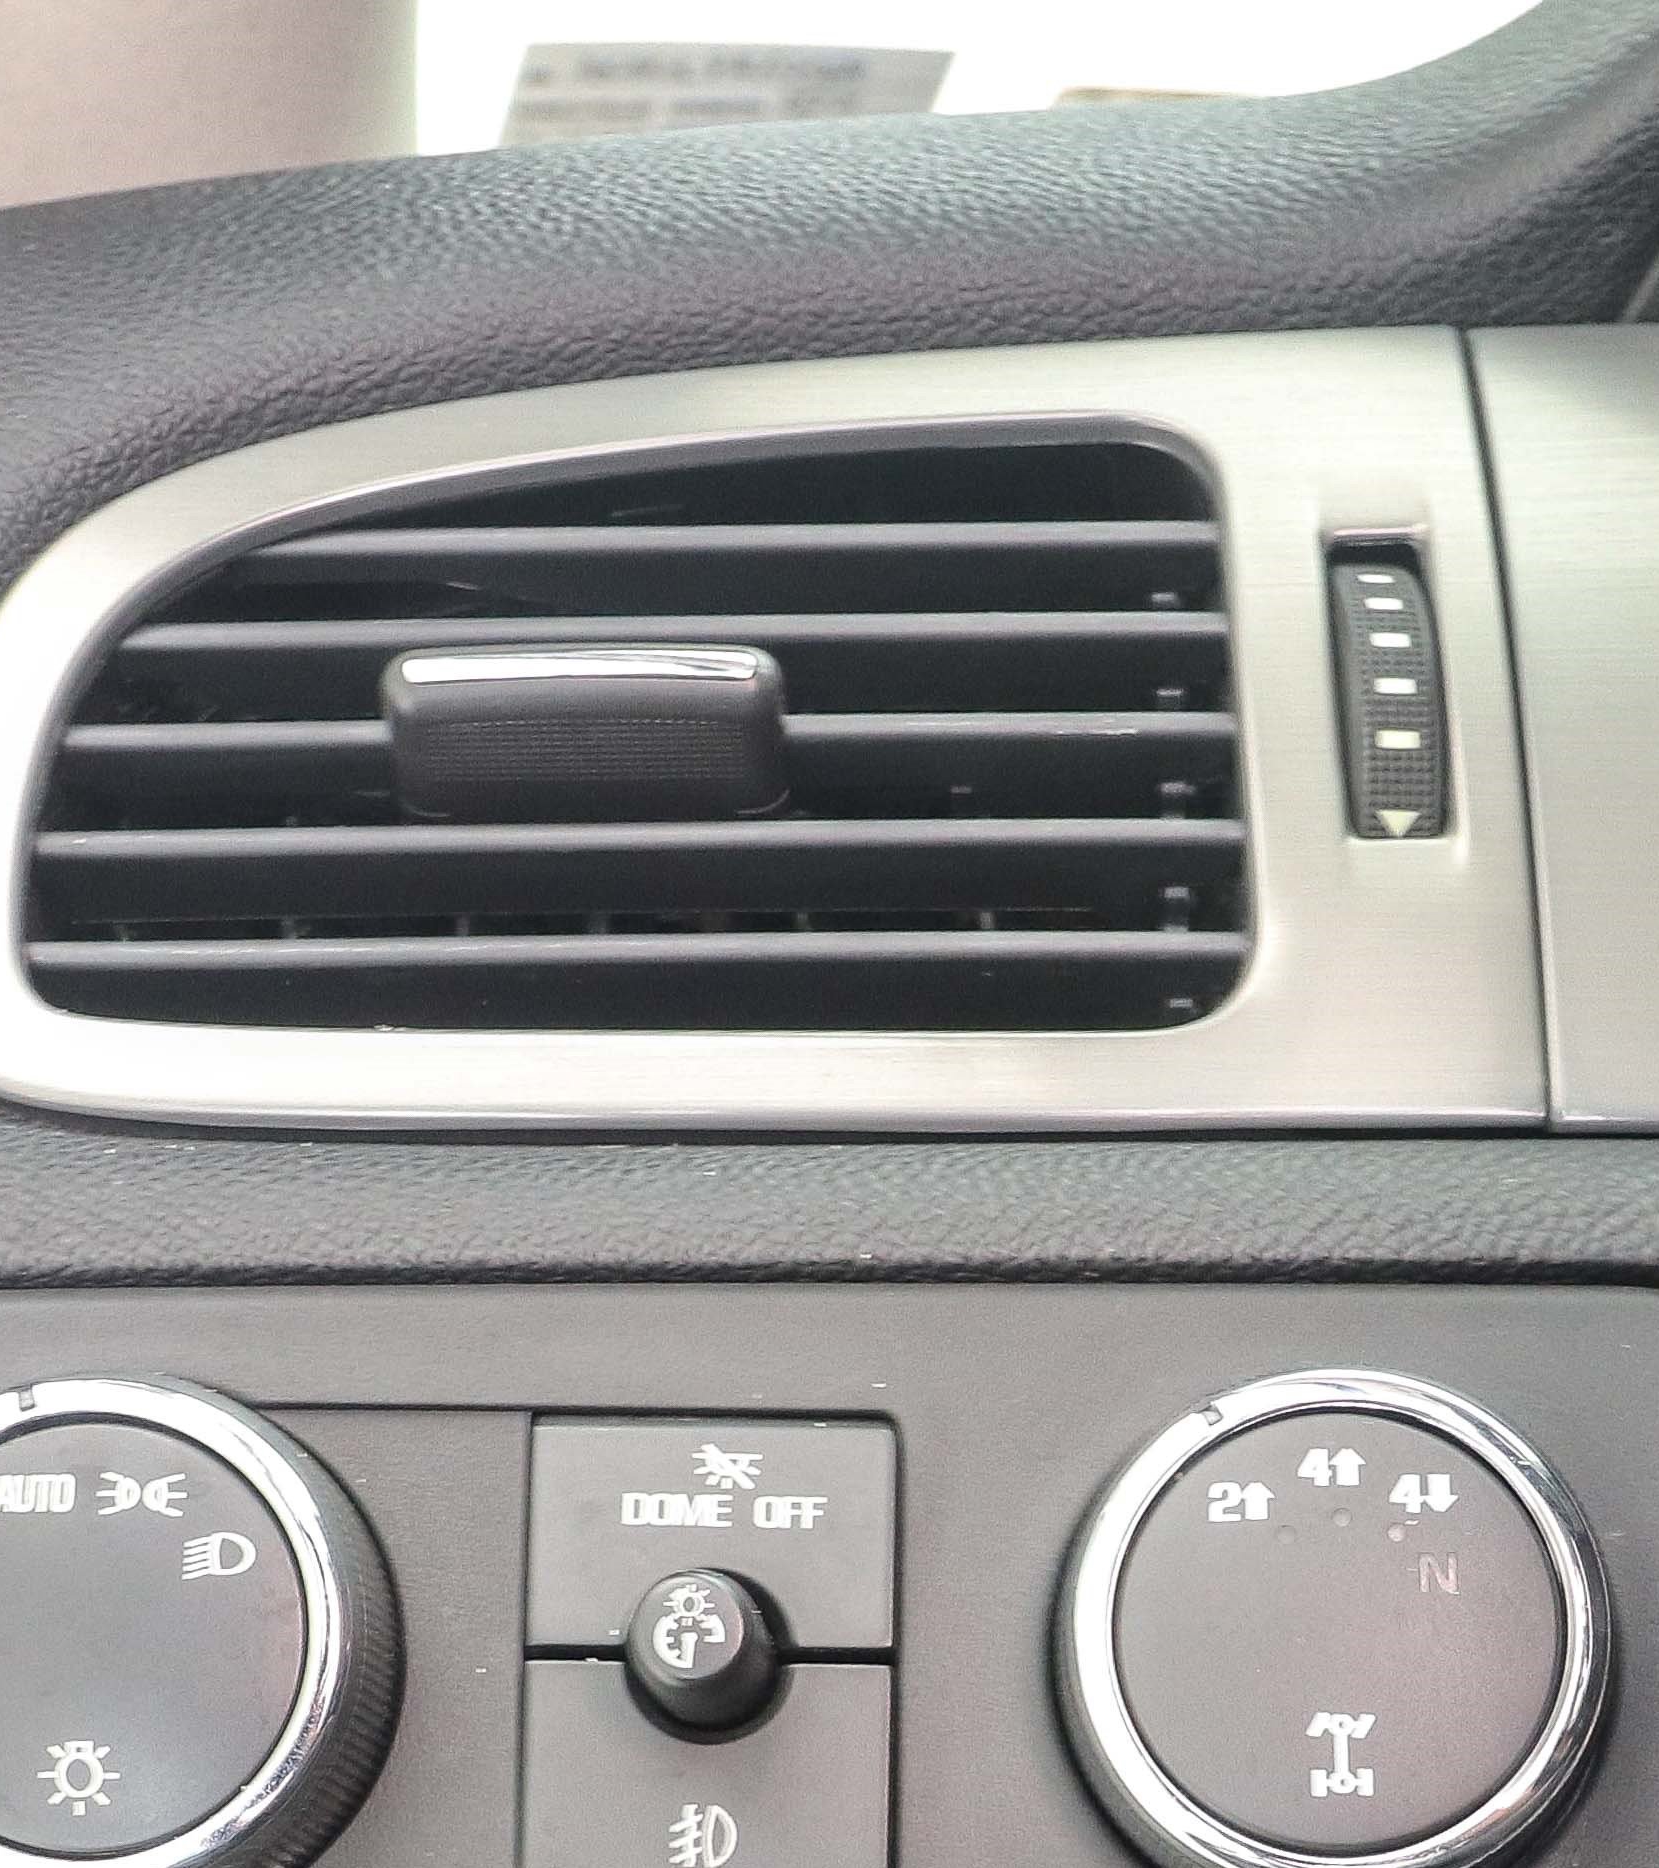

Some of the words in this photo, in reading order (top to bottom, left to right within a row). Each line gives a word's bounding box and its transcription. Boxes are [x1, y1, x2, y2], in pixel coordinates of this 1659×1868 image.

[620, 1491, 733, 1528] DOME
[753, 1496, 829, 1530] OFF
[1417, 1551, 1460, 1595] N
